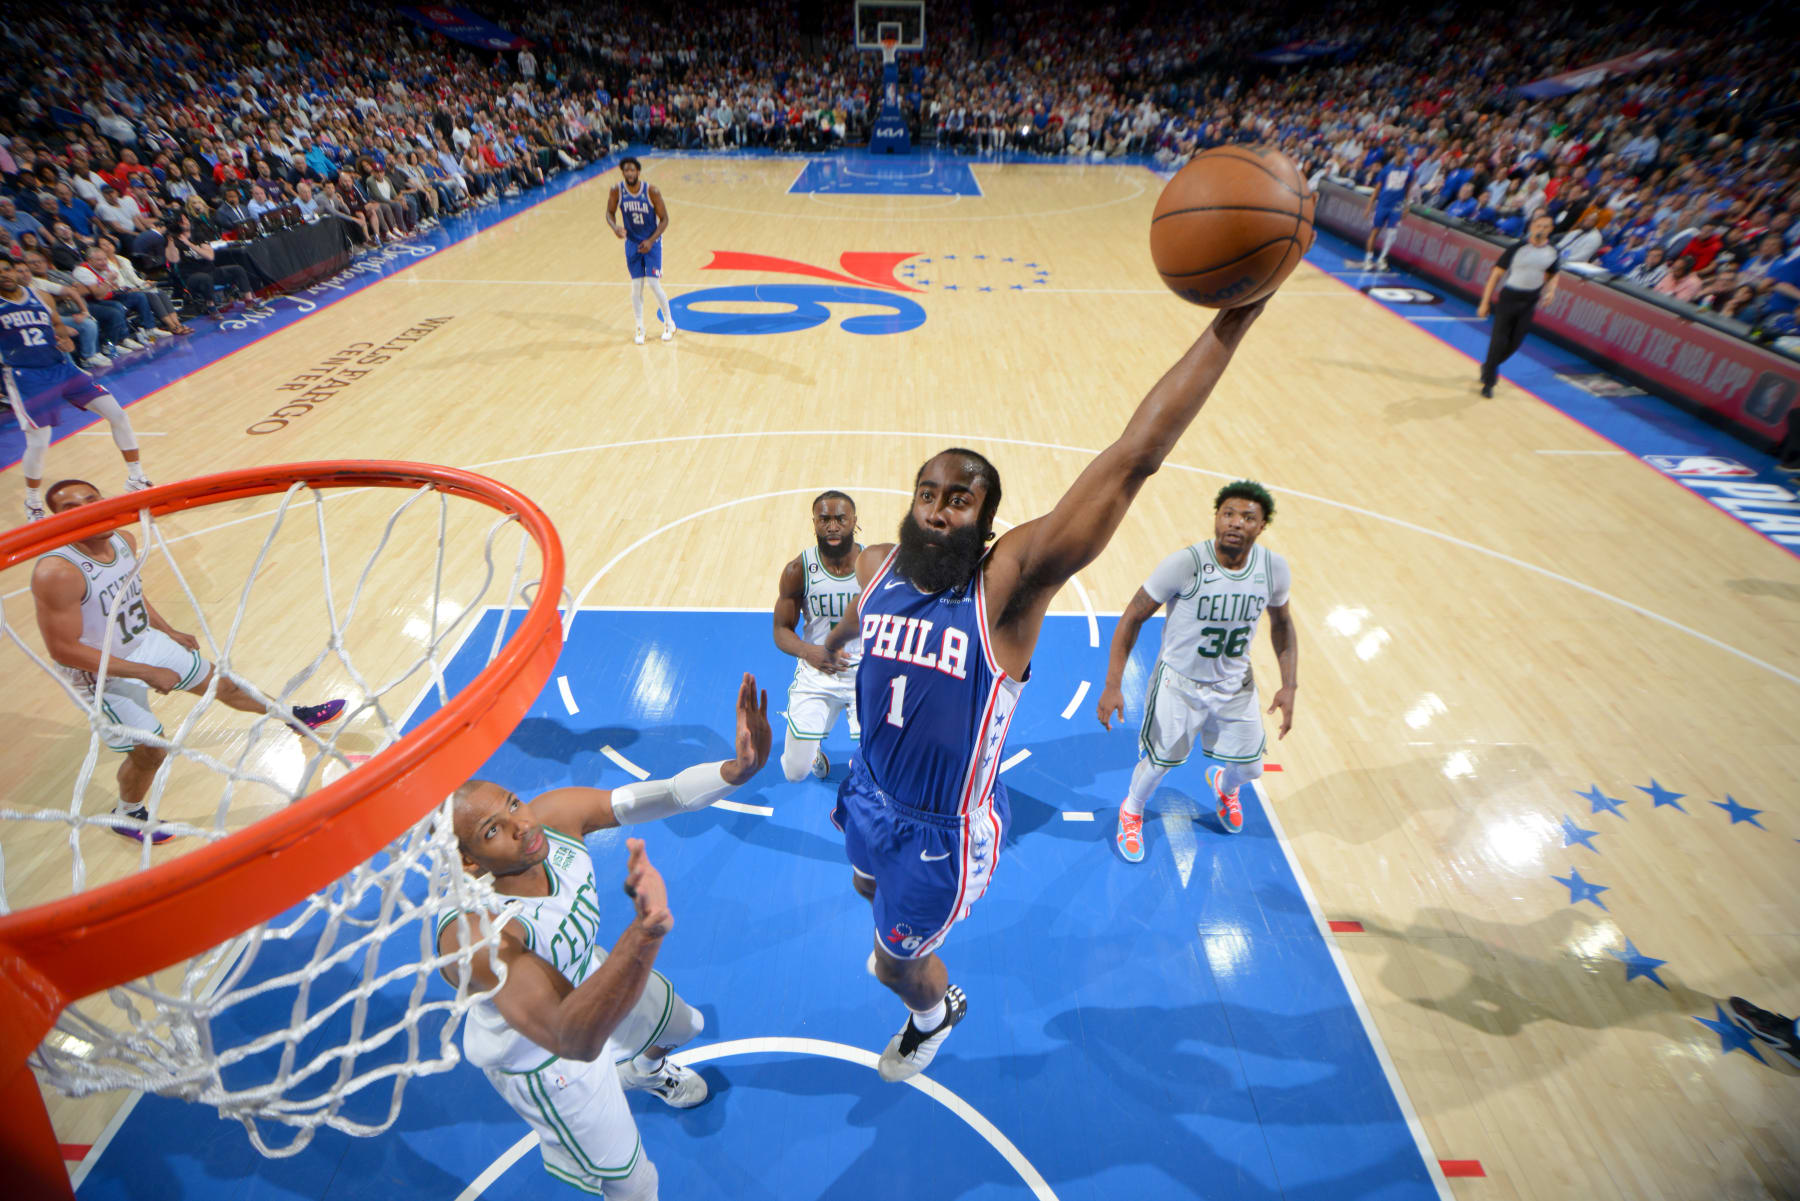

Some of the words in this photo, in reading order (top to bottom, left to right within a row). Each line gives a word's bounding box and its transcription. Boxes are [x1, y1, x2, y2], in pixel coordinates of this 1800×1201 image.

[877, 128, 904, 138] KIA
[623, 200, 649, 214] PHILA
[632, 213, 645, 225] 21
[0, 310, 49, 329] PHILA
[20, 327, 48, 346] 12
[356, 315, 454, 365] WELLS
[1566, 296, 1612, 338] MODE
[1604, 310, 1648, 354] WITH
[1641, 326, 1682, 368] THE
[1671, 340, 1714, 385] NBA
[1704, 357, 1754, 400] APP
[276, 342, 374, 391] CENTER
[246, 368, 373, 435] FARGO
[116, 599, 148, 645] 13
[1197, 593, 1265, 621] CELTICS
[860, 614, 969, 681] PHILA
[1198, 625, 1252, 659] 36
[886, 674, 908, 728] 1
